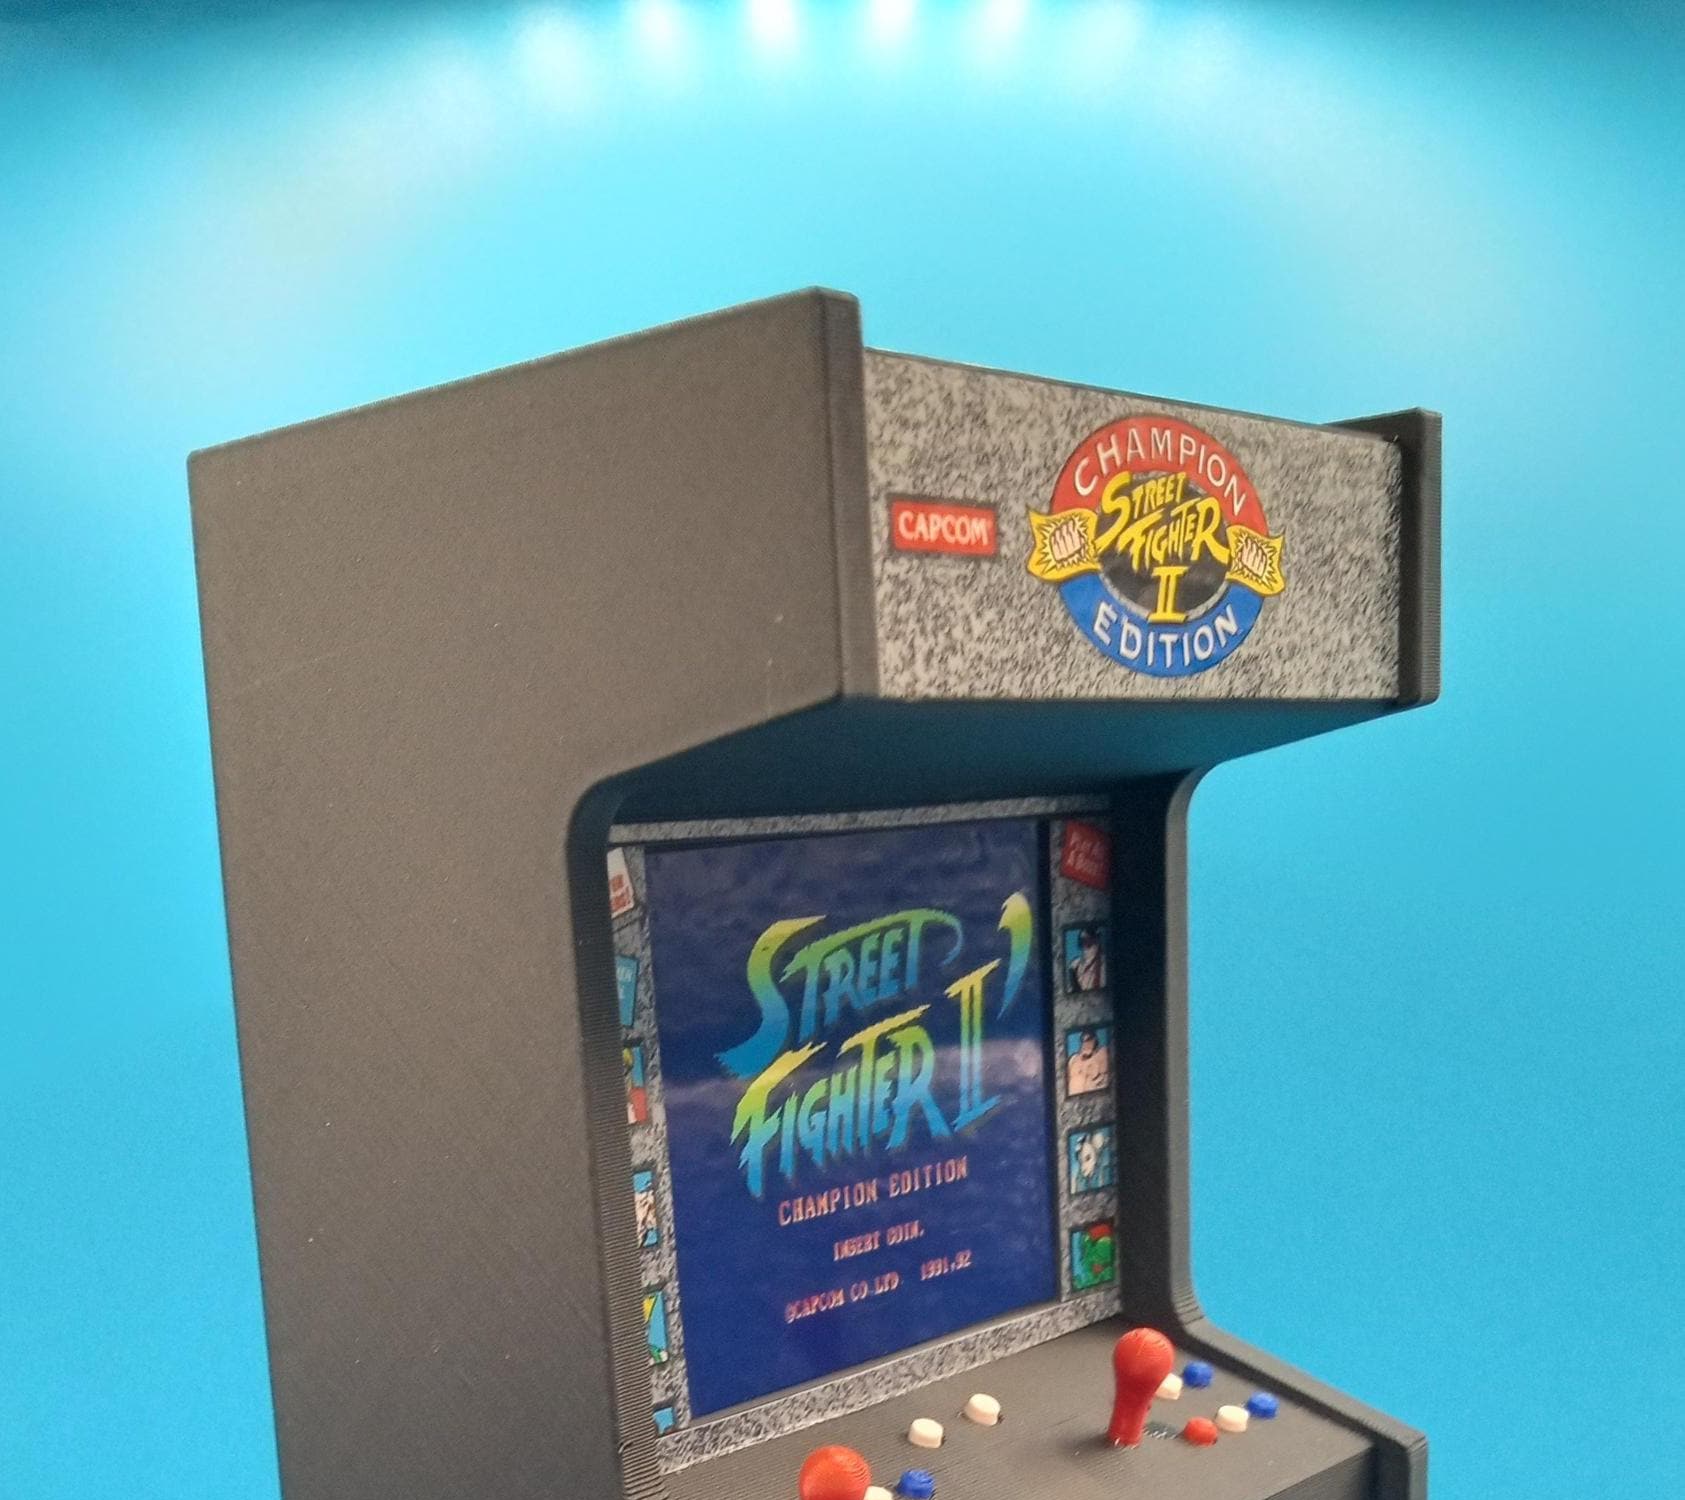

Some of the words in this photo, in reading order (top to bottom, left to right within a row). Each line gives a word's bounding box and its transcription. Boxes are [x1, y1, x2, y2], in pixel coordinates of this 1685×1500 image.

[1074, 427, 1247, 516] CHAMPION
[898, 510, 989, 546] CAPCOM
[1095, 471, 1188, 553] STREET
[1117, 496, 1230, 572] FIGHTER
[1148, 565, 1188, 623] II
[1093, 602, 1239, 668] EDITION
[713, 907, 964, 1080] STREET
[730, 1004, 953, 1198] FIGHTER
[778, 1178, 879, 1227] CHAMPION
[888, 1155, 968, 1198] EDITION
[833, 1231, 880, 1262] INSERT
